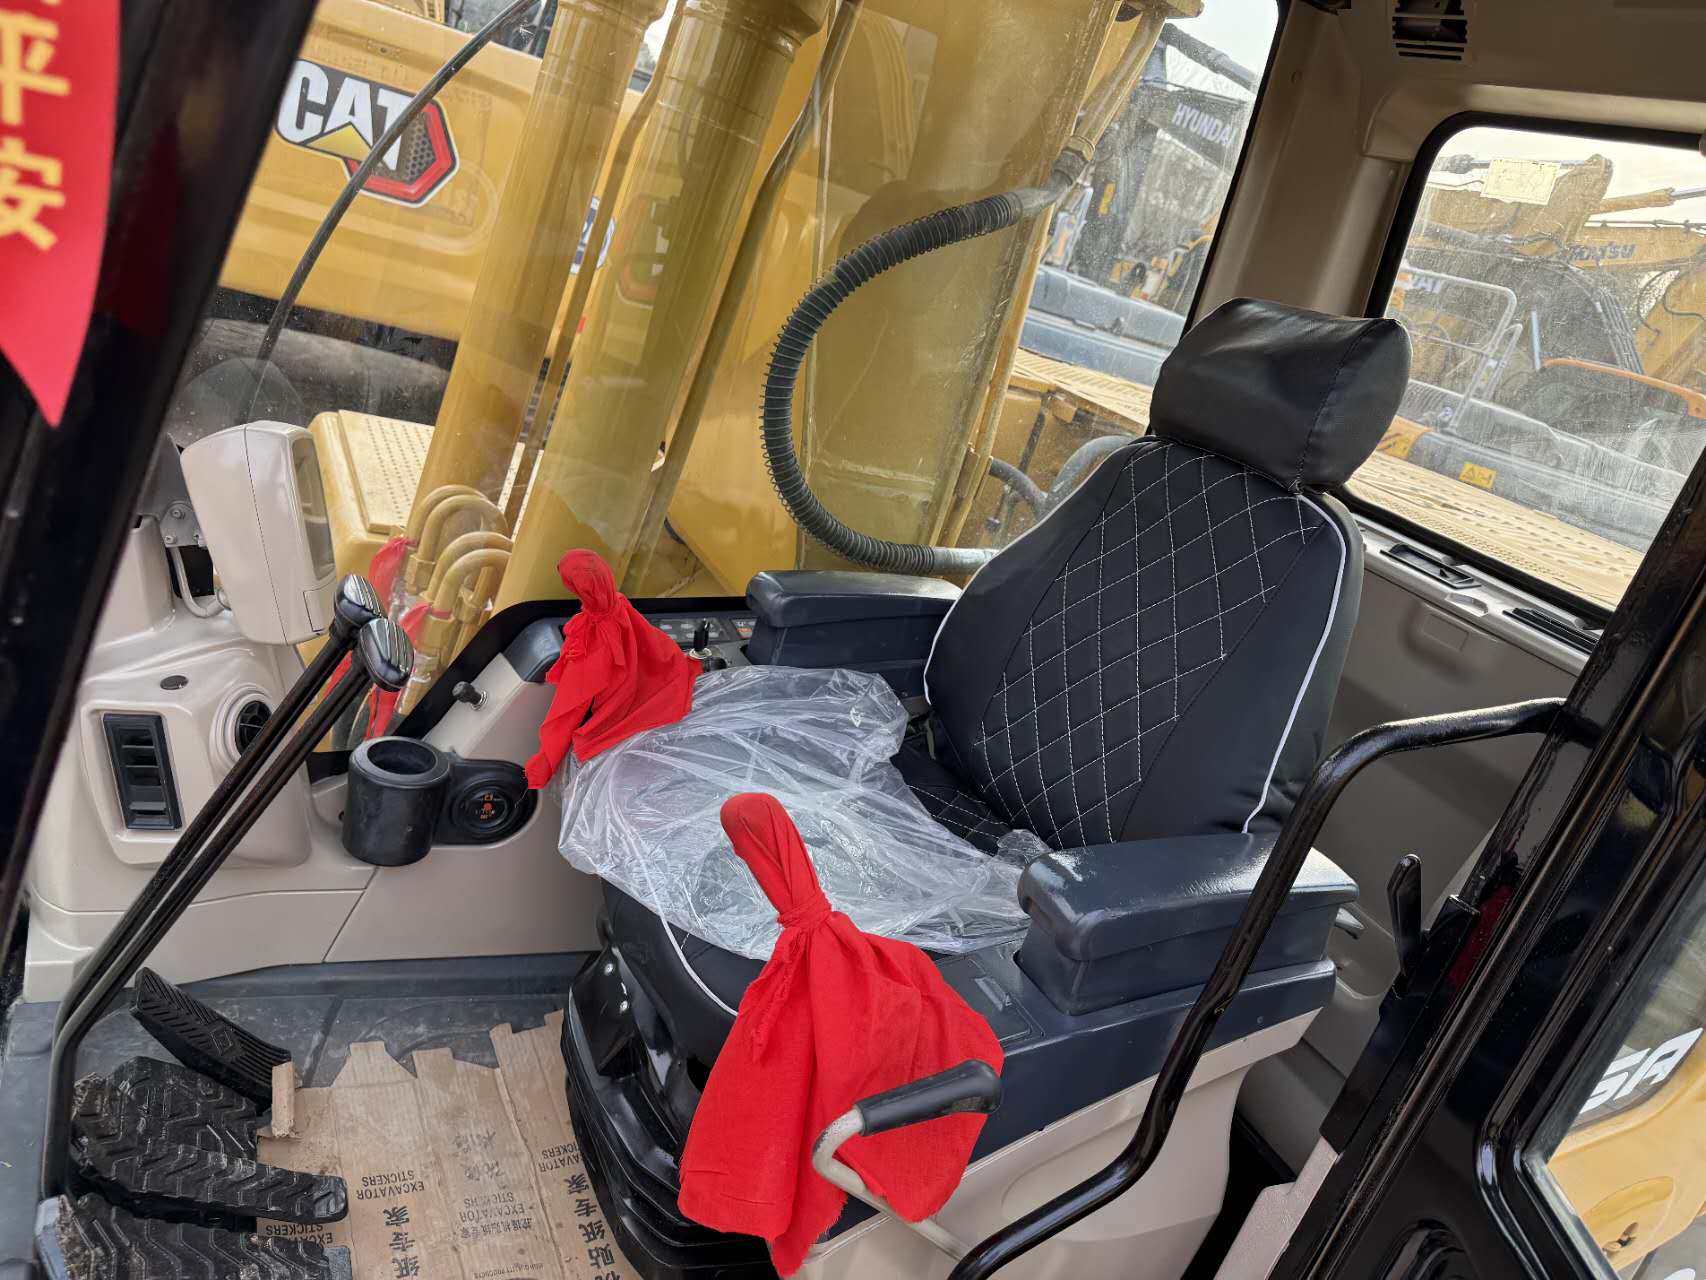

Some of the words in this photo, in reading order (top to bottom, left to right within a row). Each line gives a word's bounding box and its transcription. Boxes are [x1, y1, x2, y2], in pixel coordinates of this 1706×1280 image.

[0, 0, 71, 251] 平安
[278, 60, 421, 171] CAT
[538, 1152, 584, 1173] AVATOR
[362, 1170, 415, 1188] STICKERS
[356, 1180, 425, 1200] EXCAVATOR
